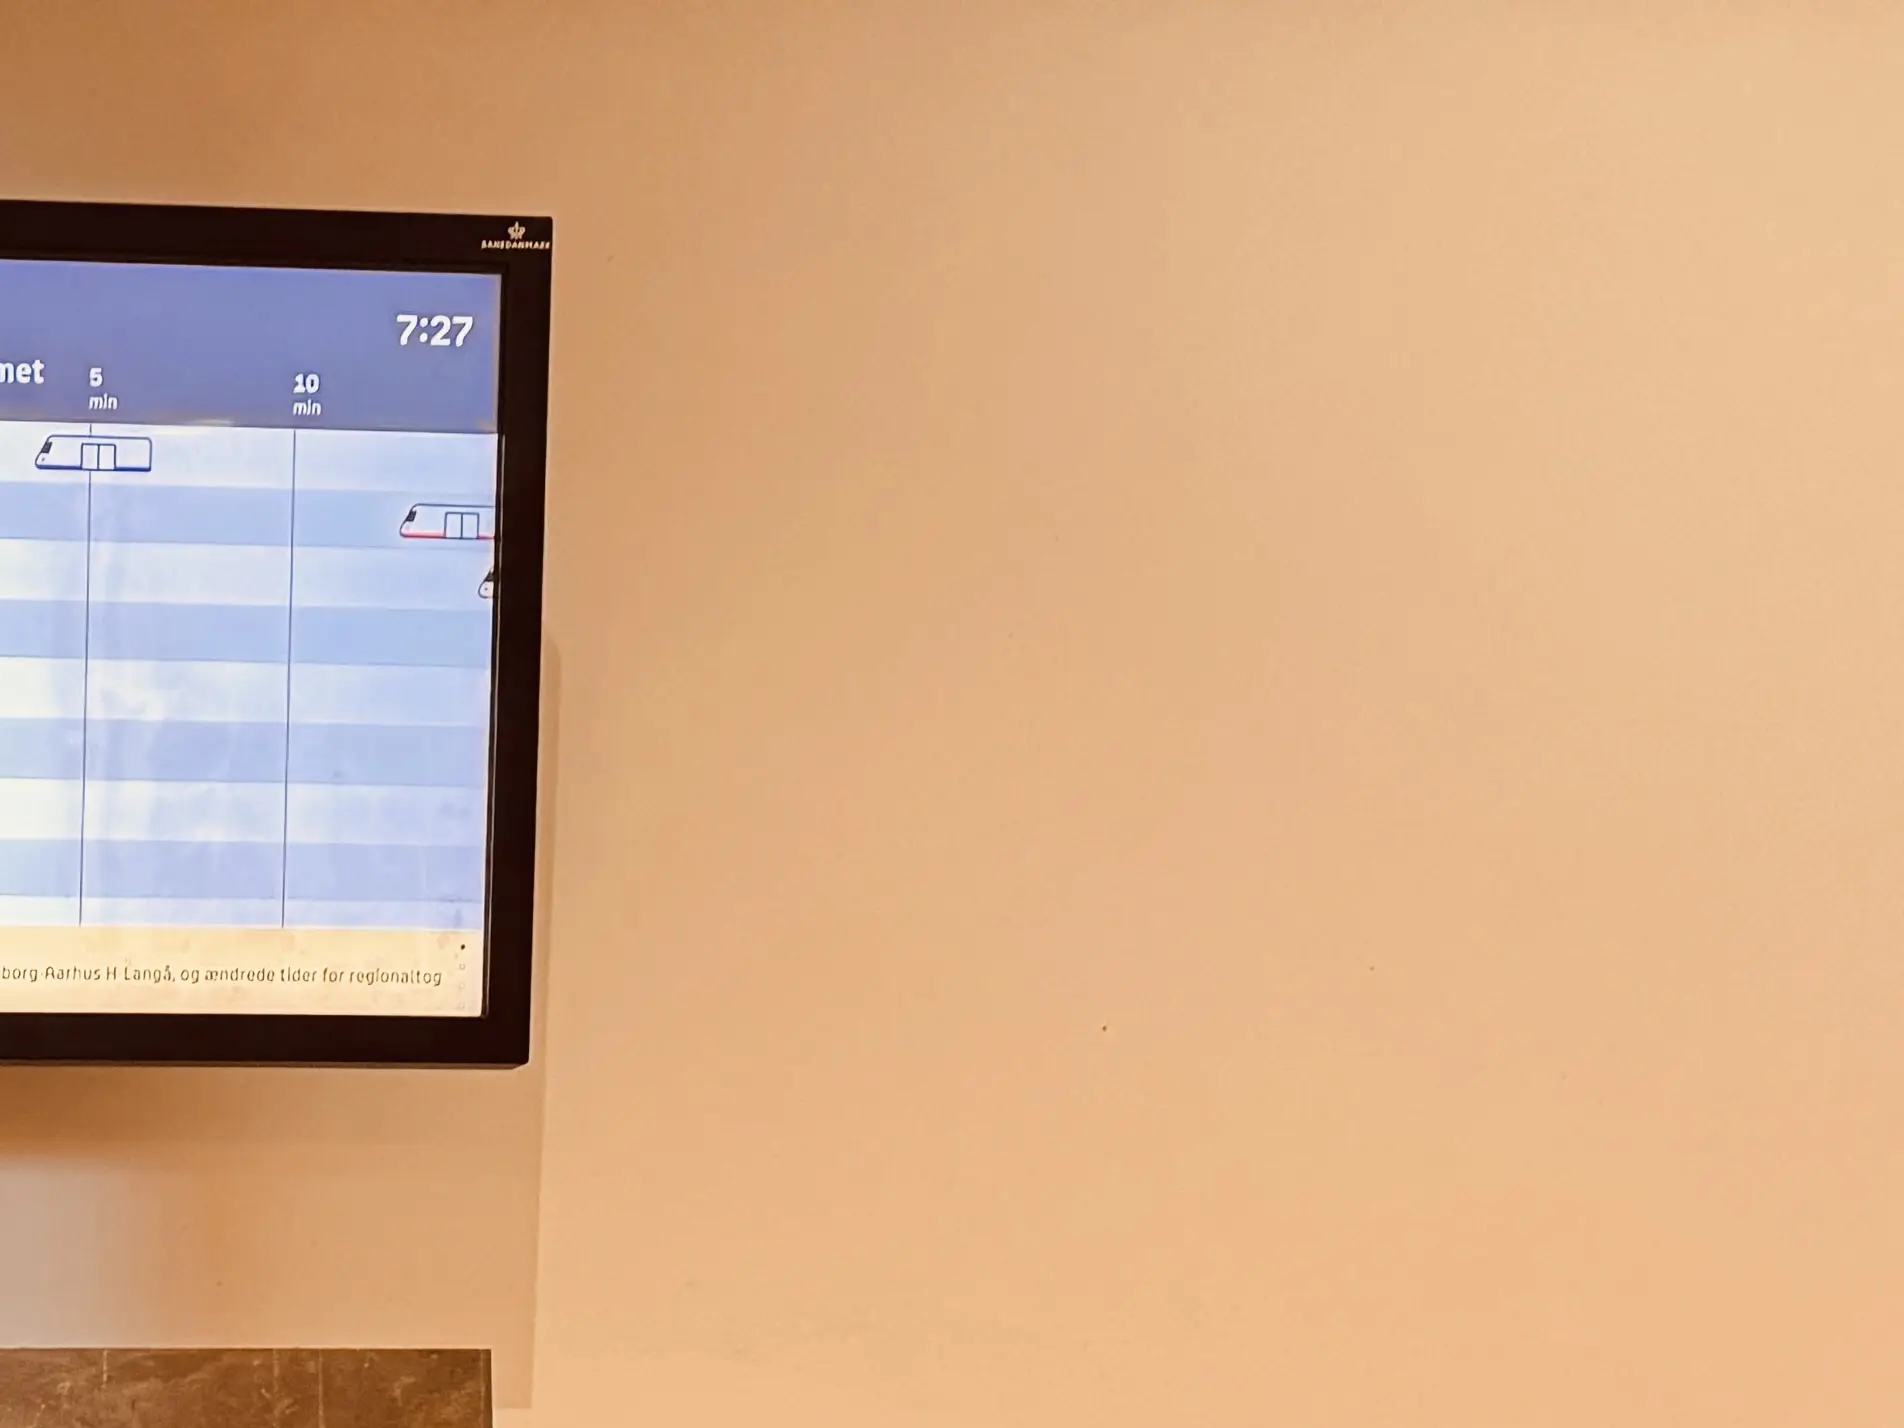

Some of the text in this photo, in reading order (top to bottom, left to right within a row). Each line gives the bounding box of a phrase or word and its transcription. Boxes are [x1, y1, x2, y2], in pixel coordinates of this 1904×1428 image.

[397, 315, 472, 347] 7:27
[90, 368, 102, 386] 5
[294, 374, 319, 393] 10
[90, 392, 117, 411] min
[293, 399, 321, 416] min
